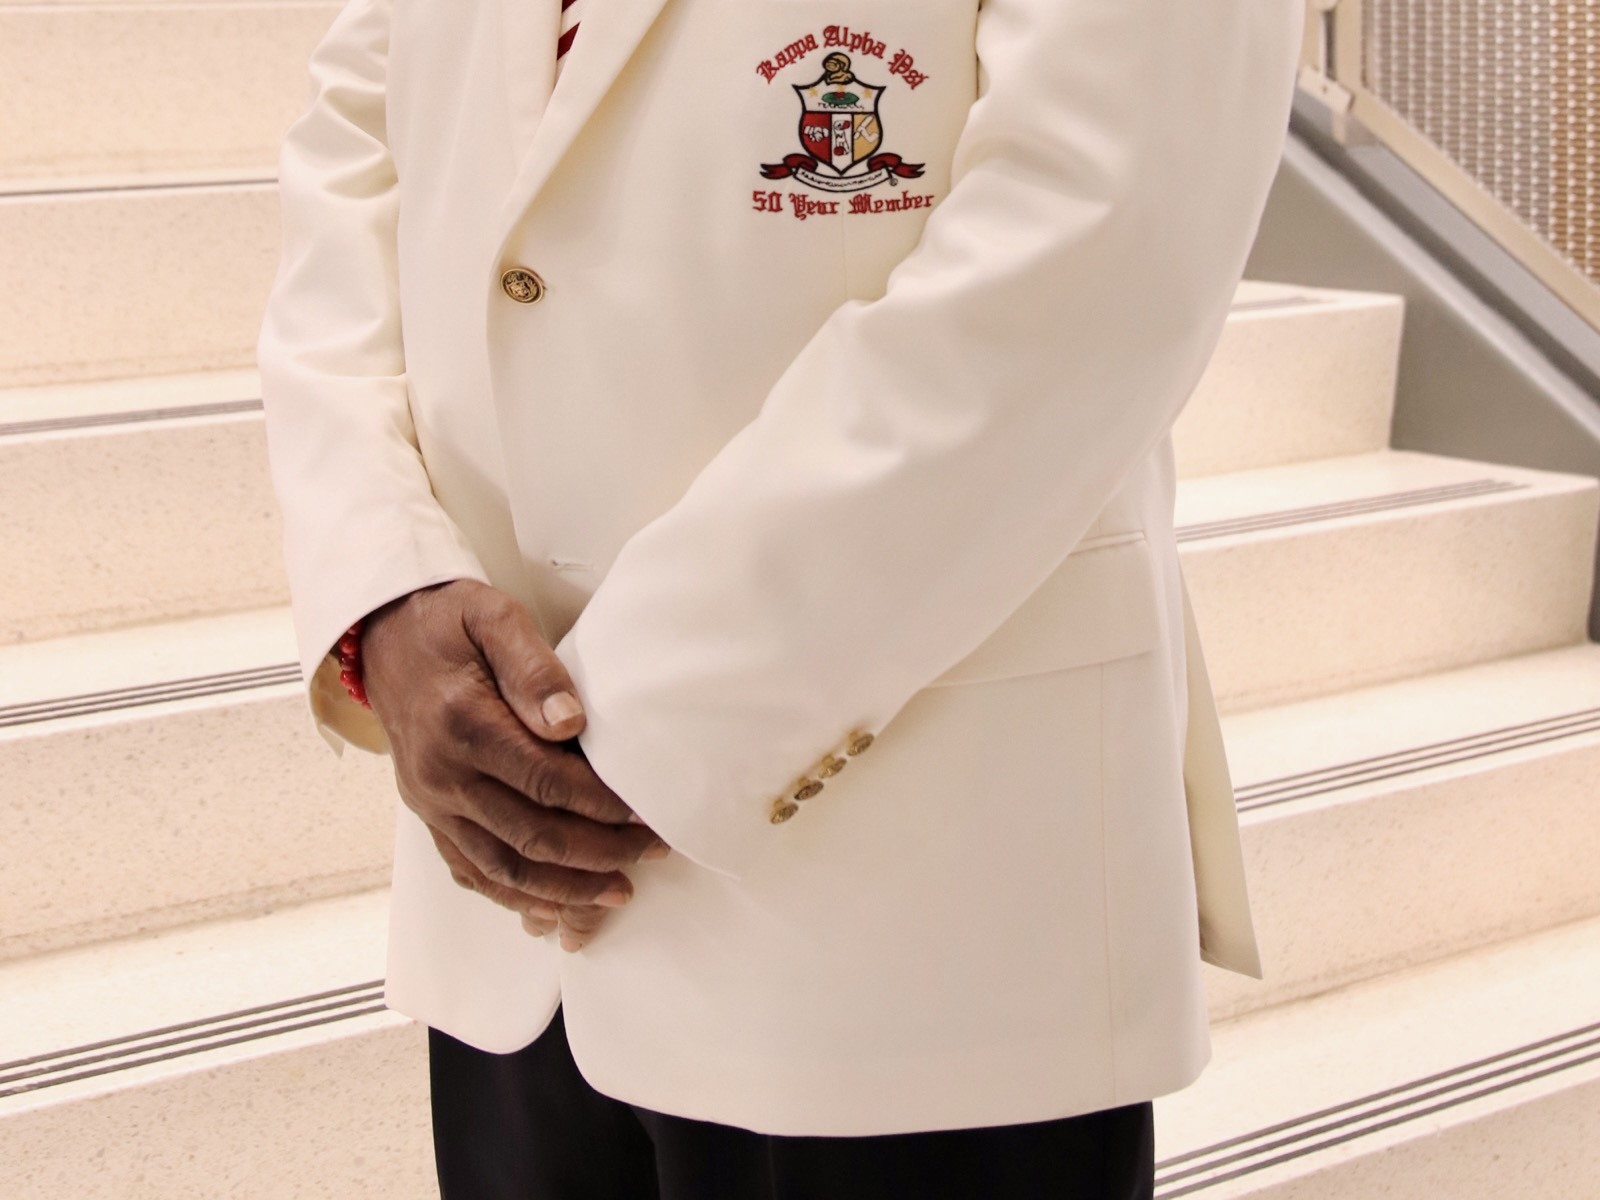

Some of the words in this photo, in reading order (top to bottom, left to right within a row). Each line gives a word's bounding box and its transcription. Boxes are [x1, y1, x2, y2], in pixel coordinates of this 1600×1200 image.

[756, 33, 819, 84] Kappa
[823, 25, 887, 59] Alpha
[888, 49, 929, 90] Psi
[752, 190, 783, 212] 50
[789, 192, 840, 221] Year
[848, 190, 935, 214] Member
